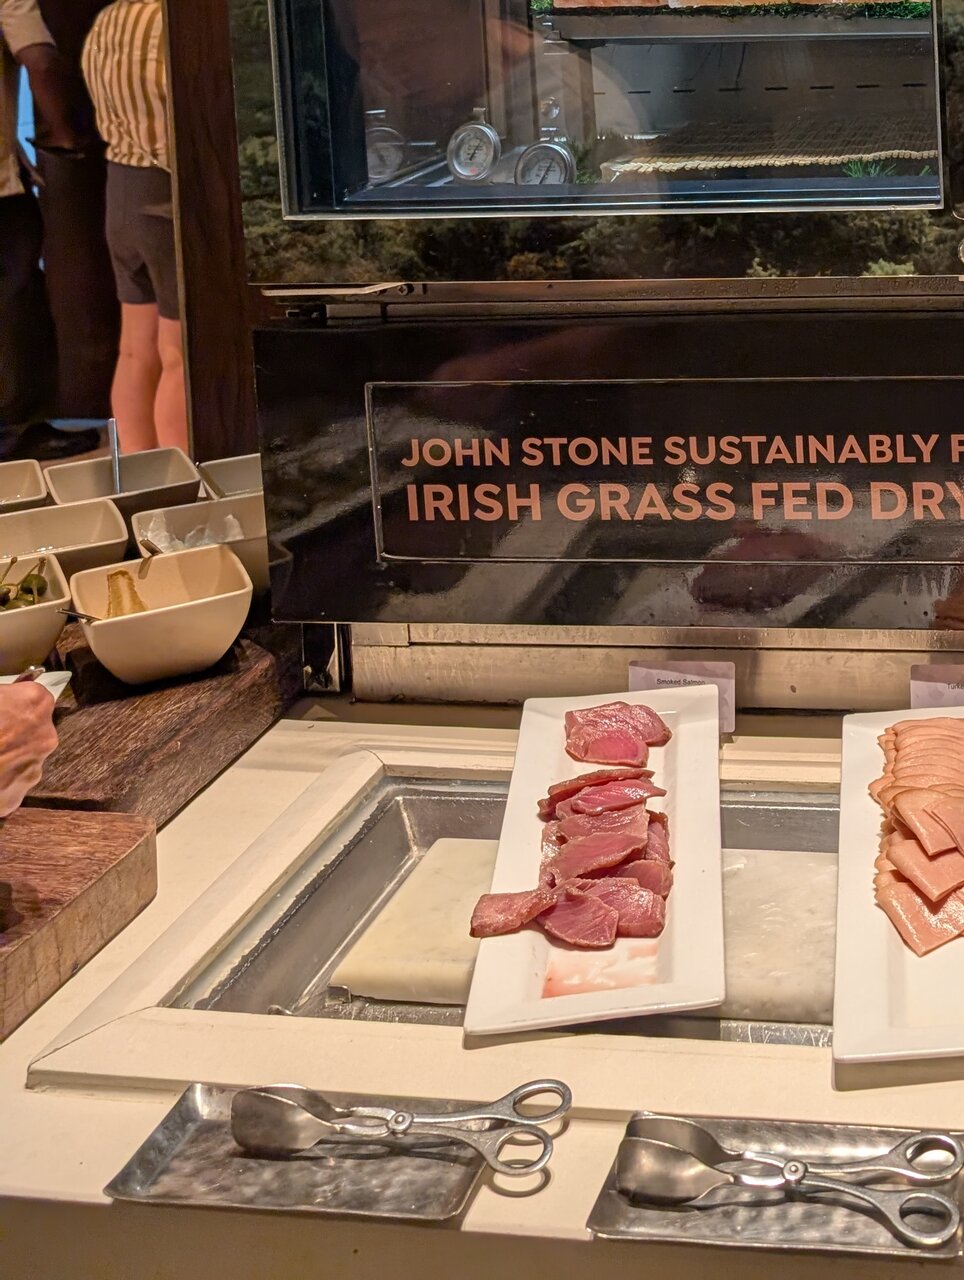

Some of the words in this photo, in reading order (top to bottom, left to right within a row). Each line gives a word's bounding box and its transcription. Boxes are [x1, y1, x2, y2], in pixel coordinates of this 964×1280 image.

[402, 438, 510, 467] JOHN
[521, 436, 654, 467] STONE
[664, 434, 939, 465] SUSTAINABLY
[407, 483, 541, 521] IRISH
[557, 482, 735, 521] GRASS
[751, 482, 854, 520] FED
[657, 678, 681, 686] Smoked
[682, 678, 706, 686] Salmon
